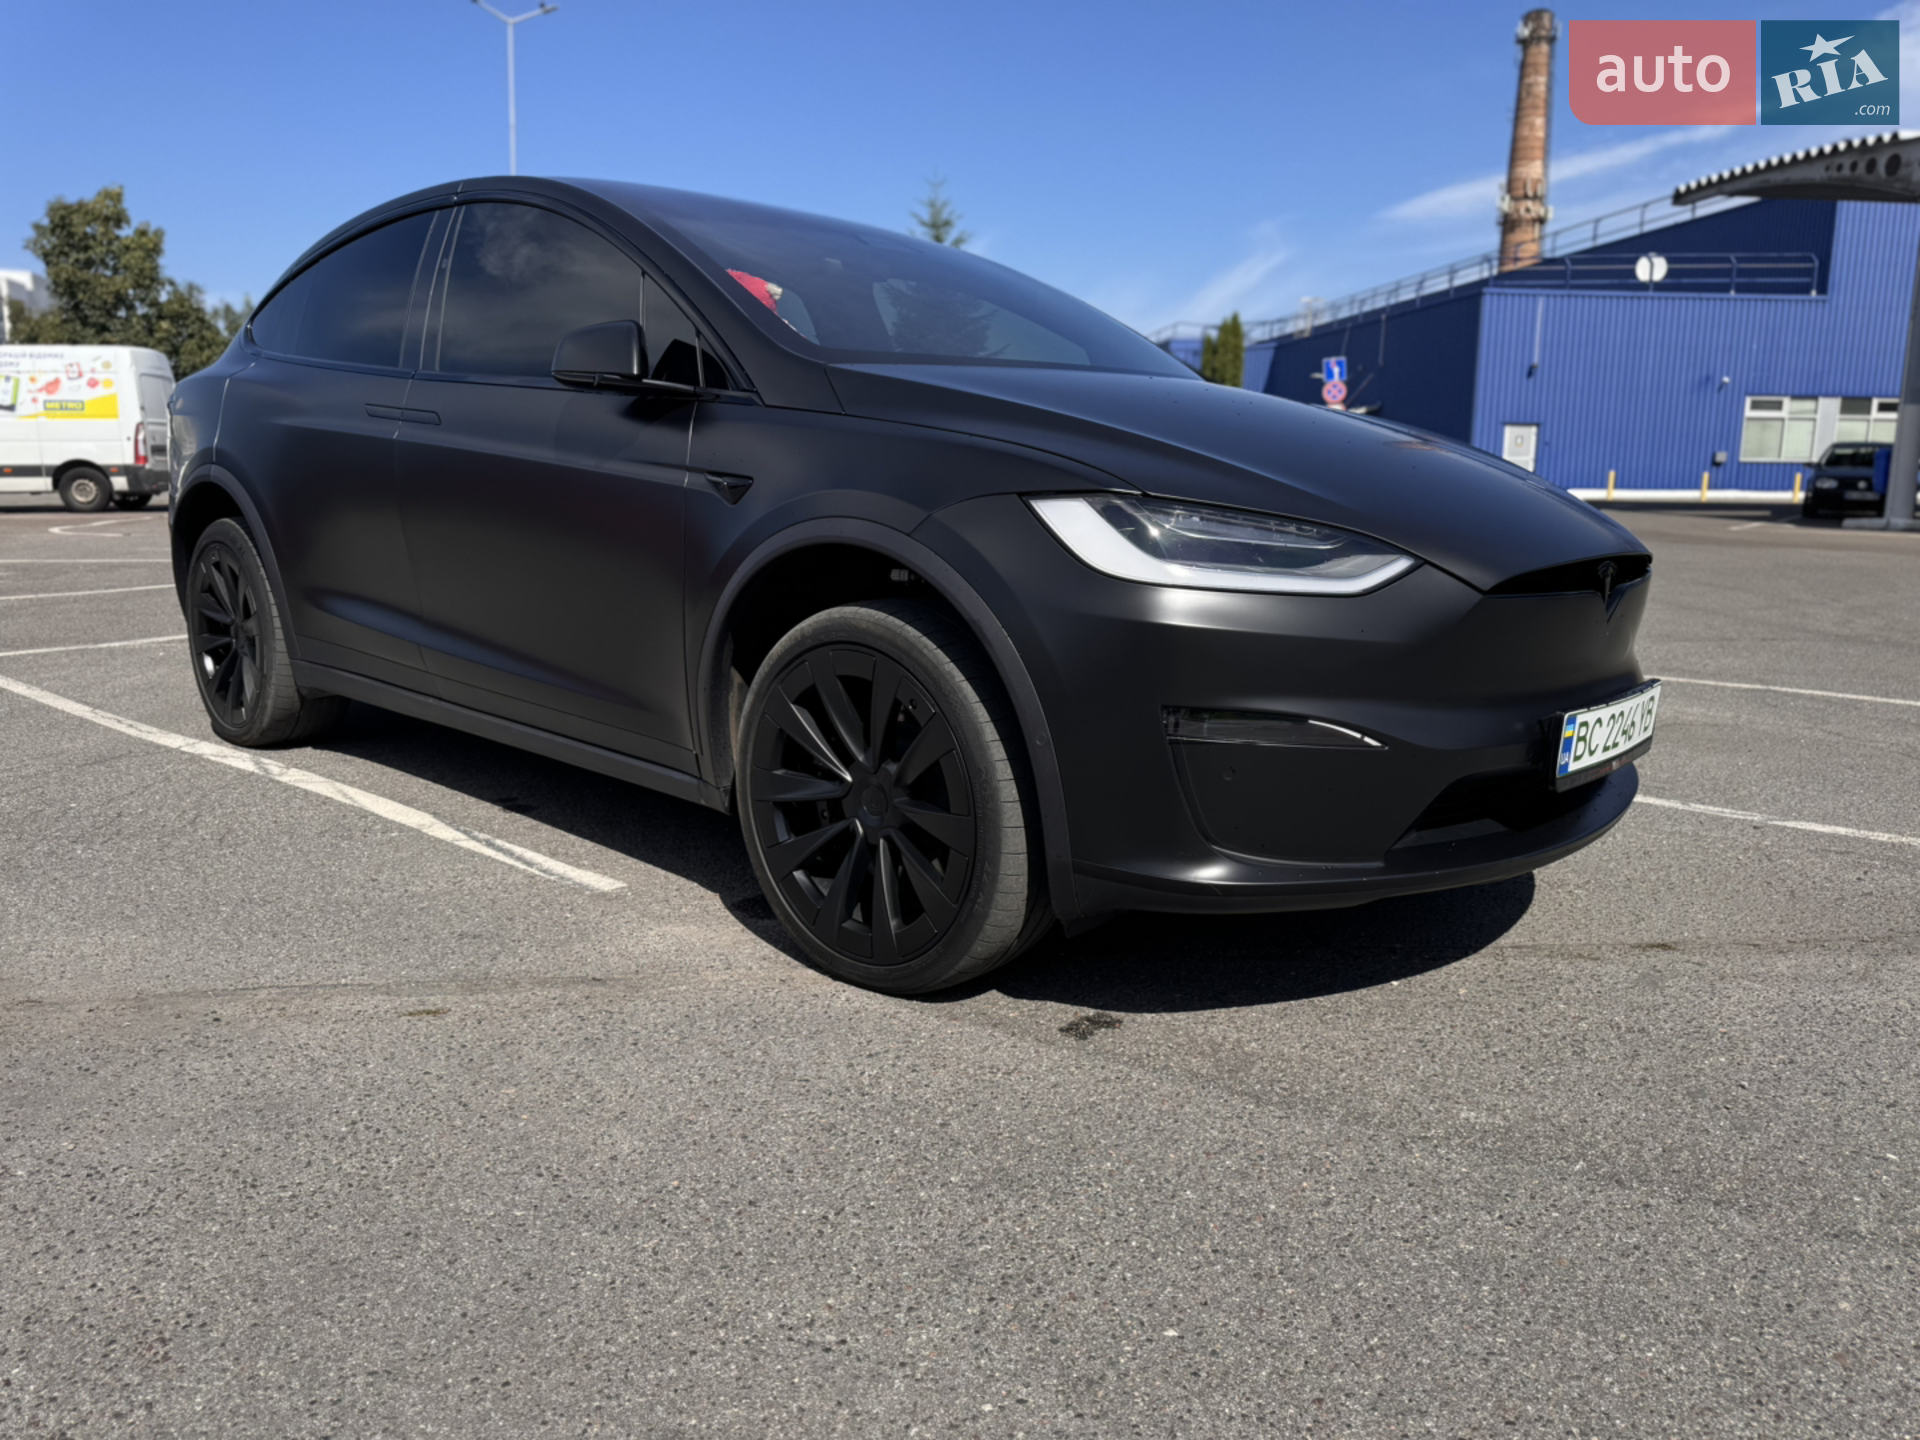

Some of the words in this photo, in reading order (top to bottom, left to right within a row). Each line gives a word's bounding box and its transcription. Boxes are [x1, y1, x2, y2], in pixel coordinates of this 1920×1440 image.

[44, 401, 84, 409] METRO
[1573, 716, 1603, 762] BC
[1602, 702, 1640, 752] 2246
[1638, 695, 1656, 736] YB
[1559, 751, 1570, 766] UA
